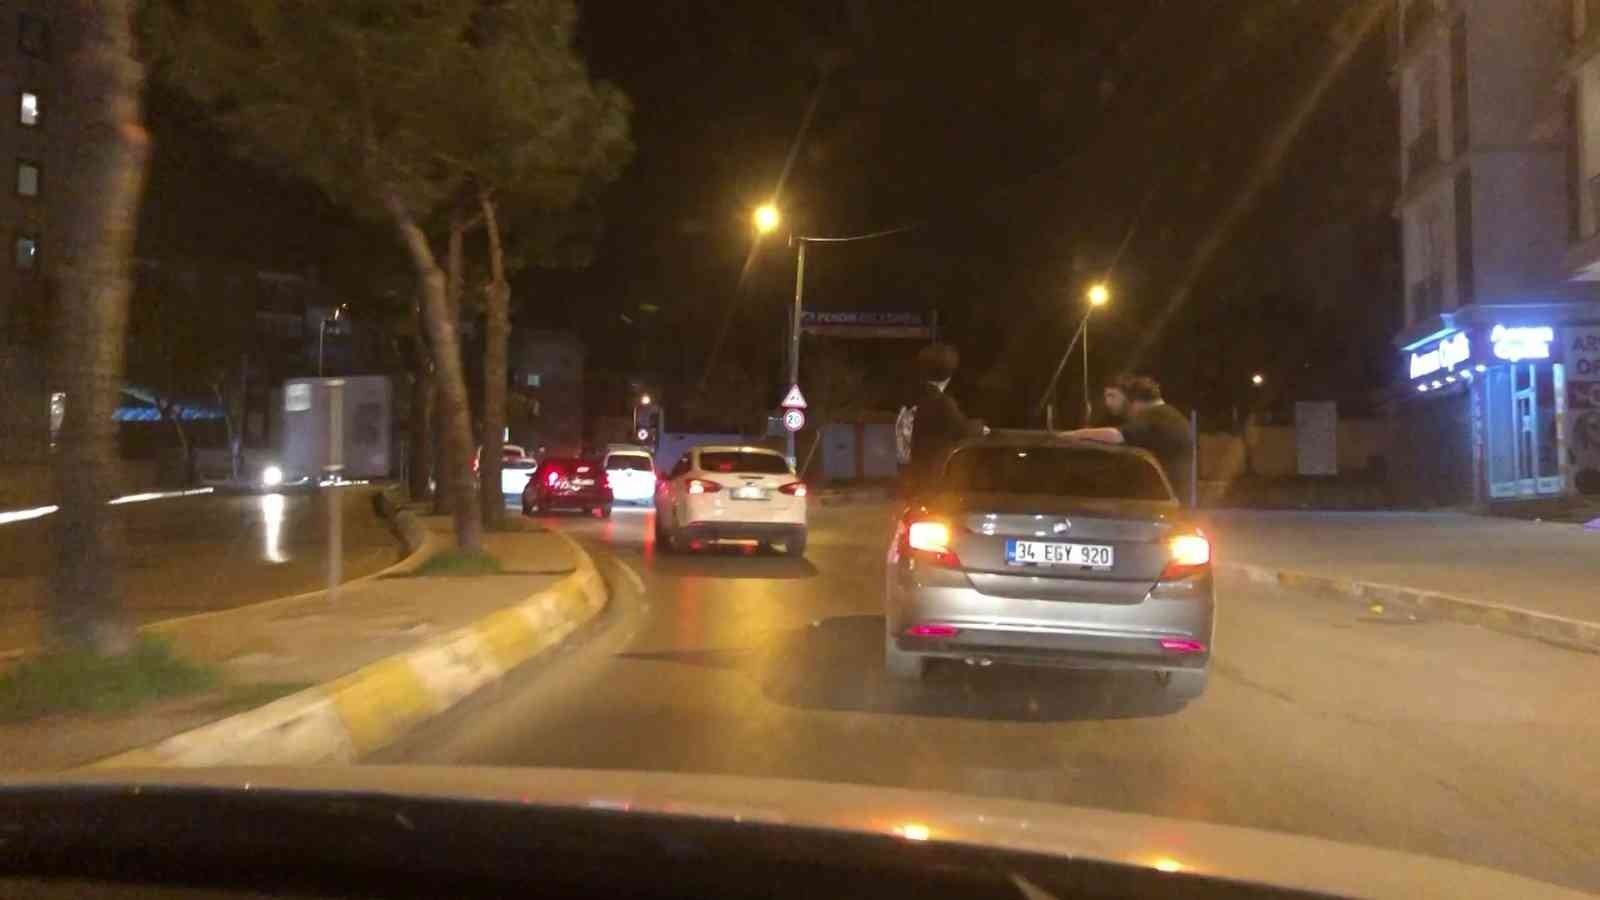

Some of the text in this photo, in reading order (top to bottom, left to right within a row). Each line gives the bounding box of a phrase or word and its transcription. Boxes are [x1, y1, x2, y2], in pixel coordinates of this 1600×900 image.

[788, 414, 801, 425] 20
[1018, 543, 1035, 559] 34
[1045, 544, 1073, 561] EGY
[1081, 546, 1109, 564] 920
